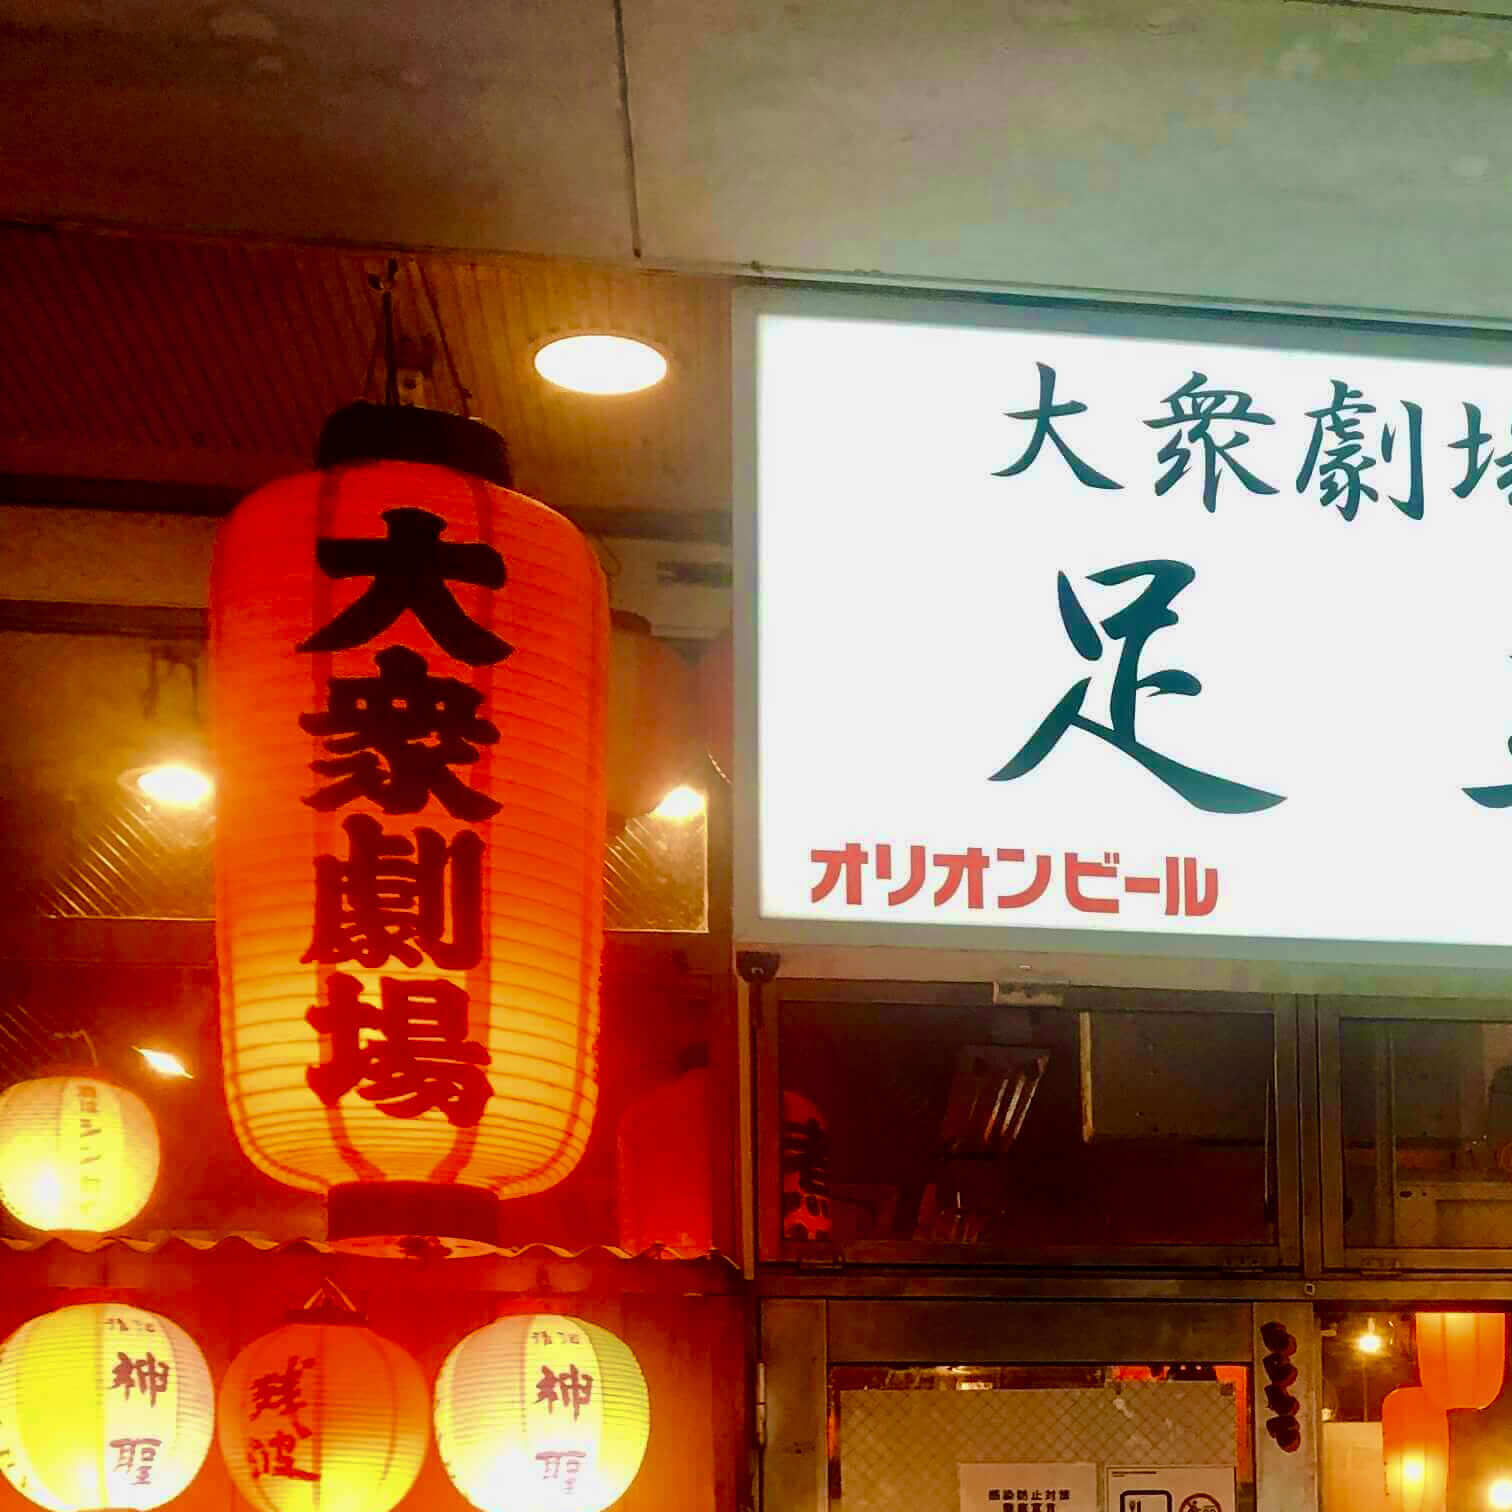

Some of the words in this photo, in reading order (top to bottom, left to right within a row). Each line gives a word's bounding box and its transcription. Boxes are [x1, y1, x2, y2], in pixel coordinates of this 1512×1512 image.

[296, 507, 514, 1127] 大衆劇場
[809, 841, 1219, 918] オリオンビール
